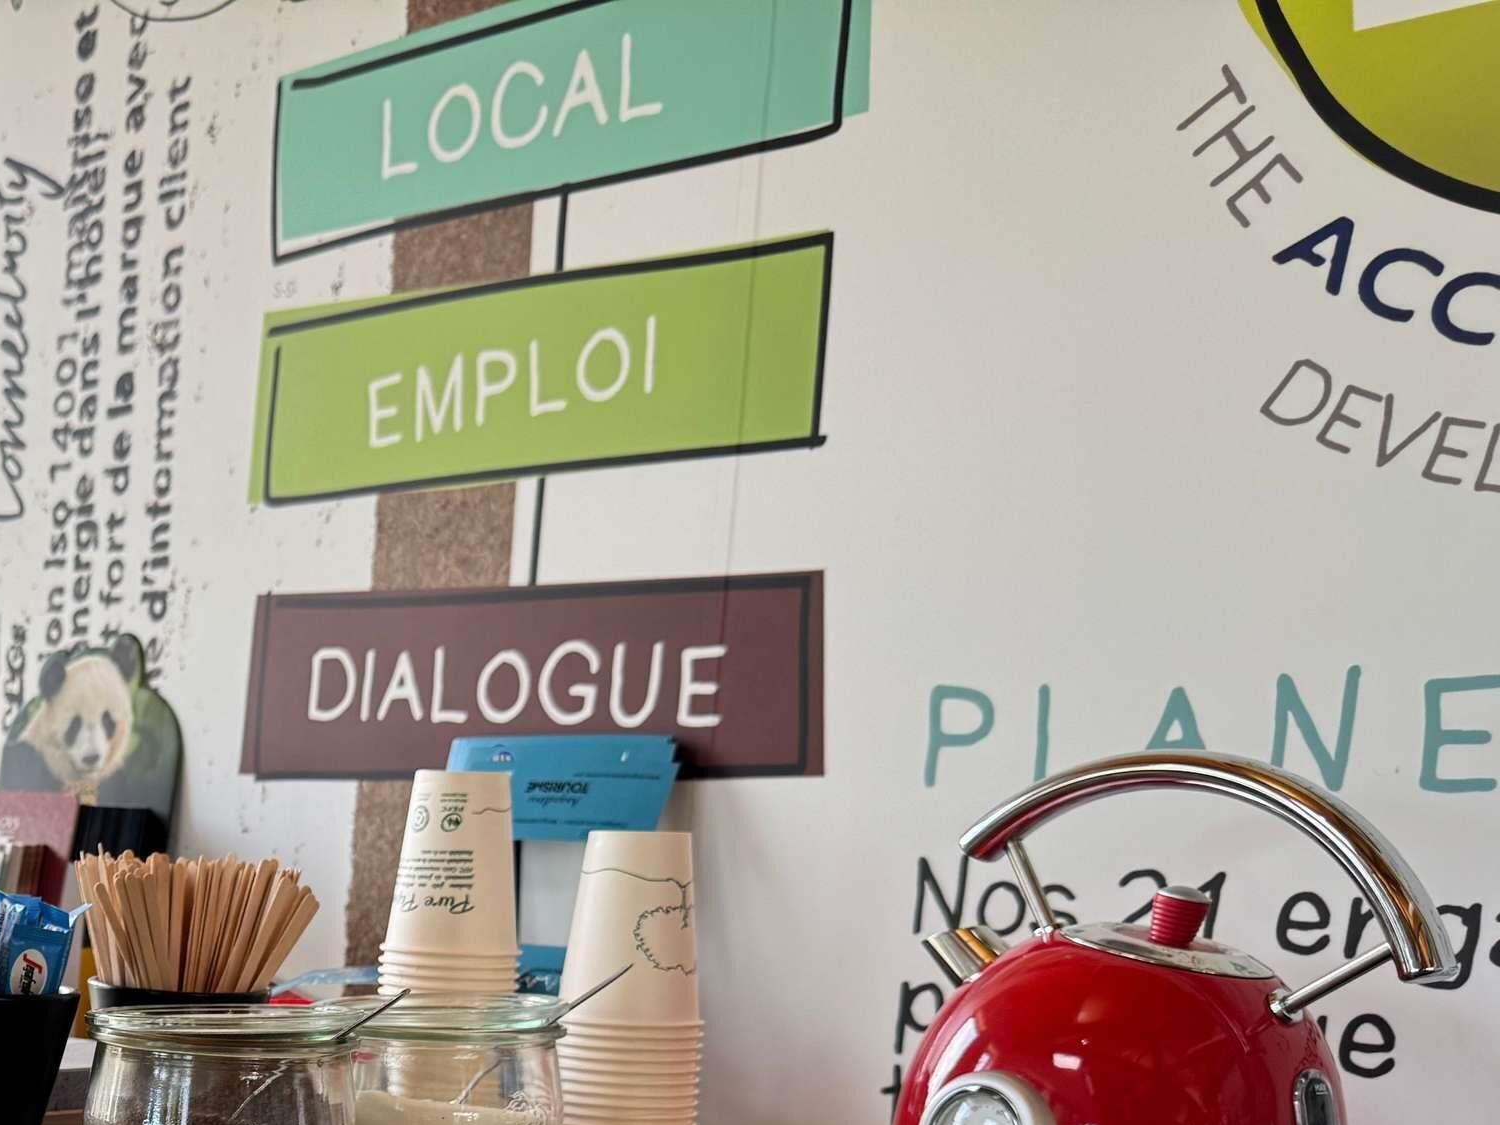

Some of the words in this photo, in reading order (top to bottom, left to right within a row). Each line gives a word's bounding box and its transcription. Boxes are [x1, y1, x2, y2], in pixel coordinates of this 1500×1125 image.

[124, 12, 149, 134] avec
[381, 32, 664, 180] LOCAL
[156, 76, 191, 232] client
[1176, 64, 1303, 228] THE
[113, 148, 147, 355] marque
[1272, 215, 1500, 346] ACC
[49, 331, 79, 482] 14001
[71, 332, 101, 457] dans
[107, 371, 134, 420] la
[140, 245, 182, 621] d'information
[367, 314, 658, 449] EMPLOI
[1259, 358, 1500, 494] DEVEL
[102, 431, 130, 496] de
[99, 512, 127, 609] fort
[307, 640, 728, 727] DIALOGUE
[422, 894, 476, 915] Pure
[912, 856, 1078, 936] Nos
